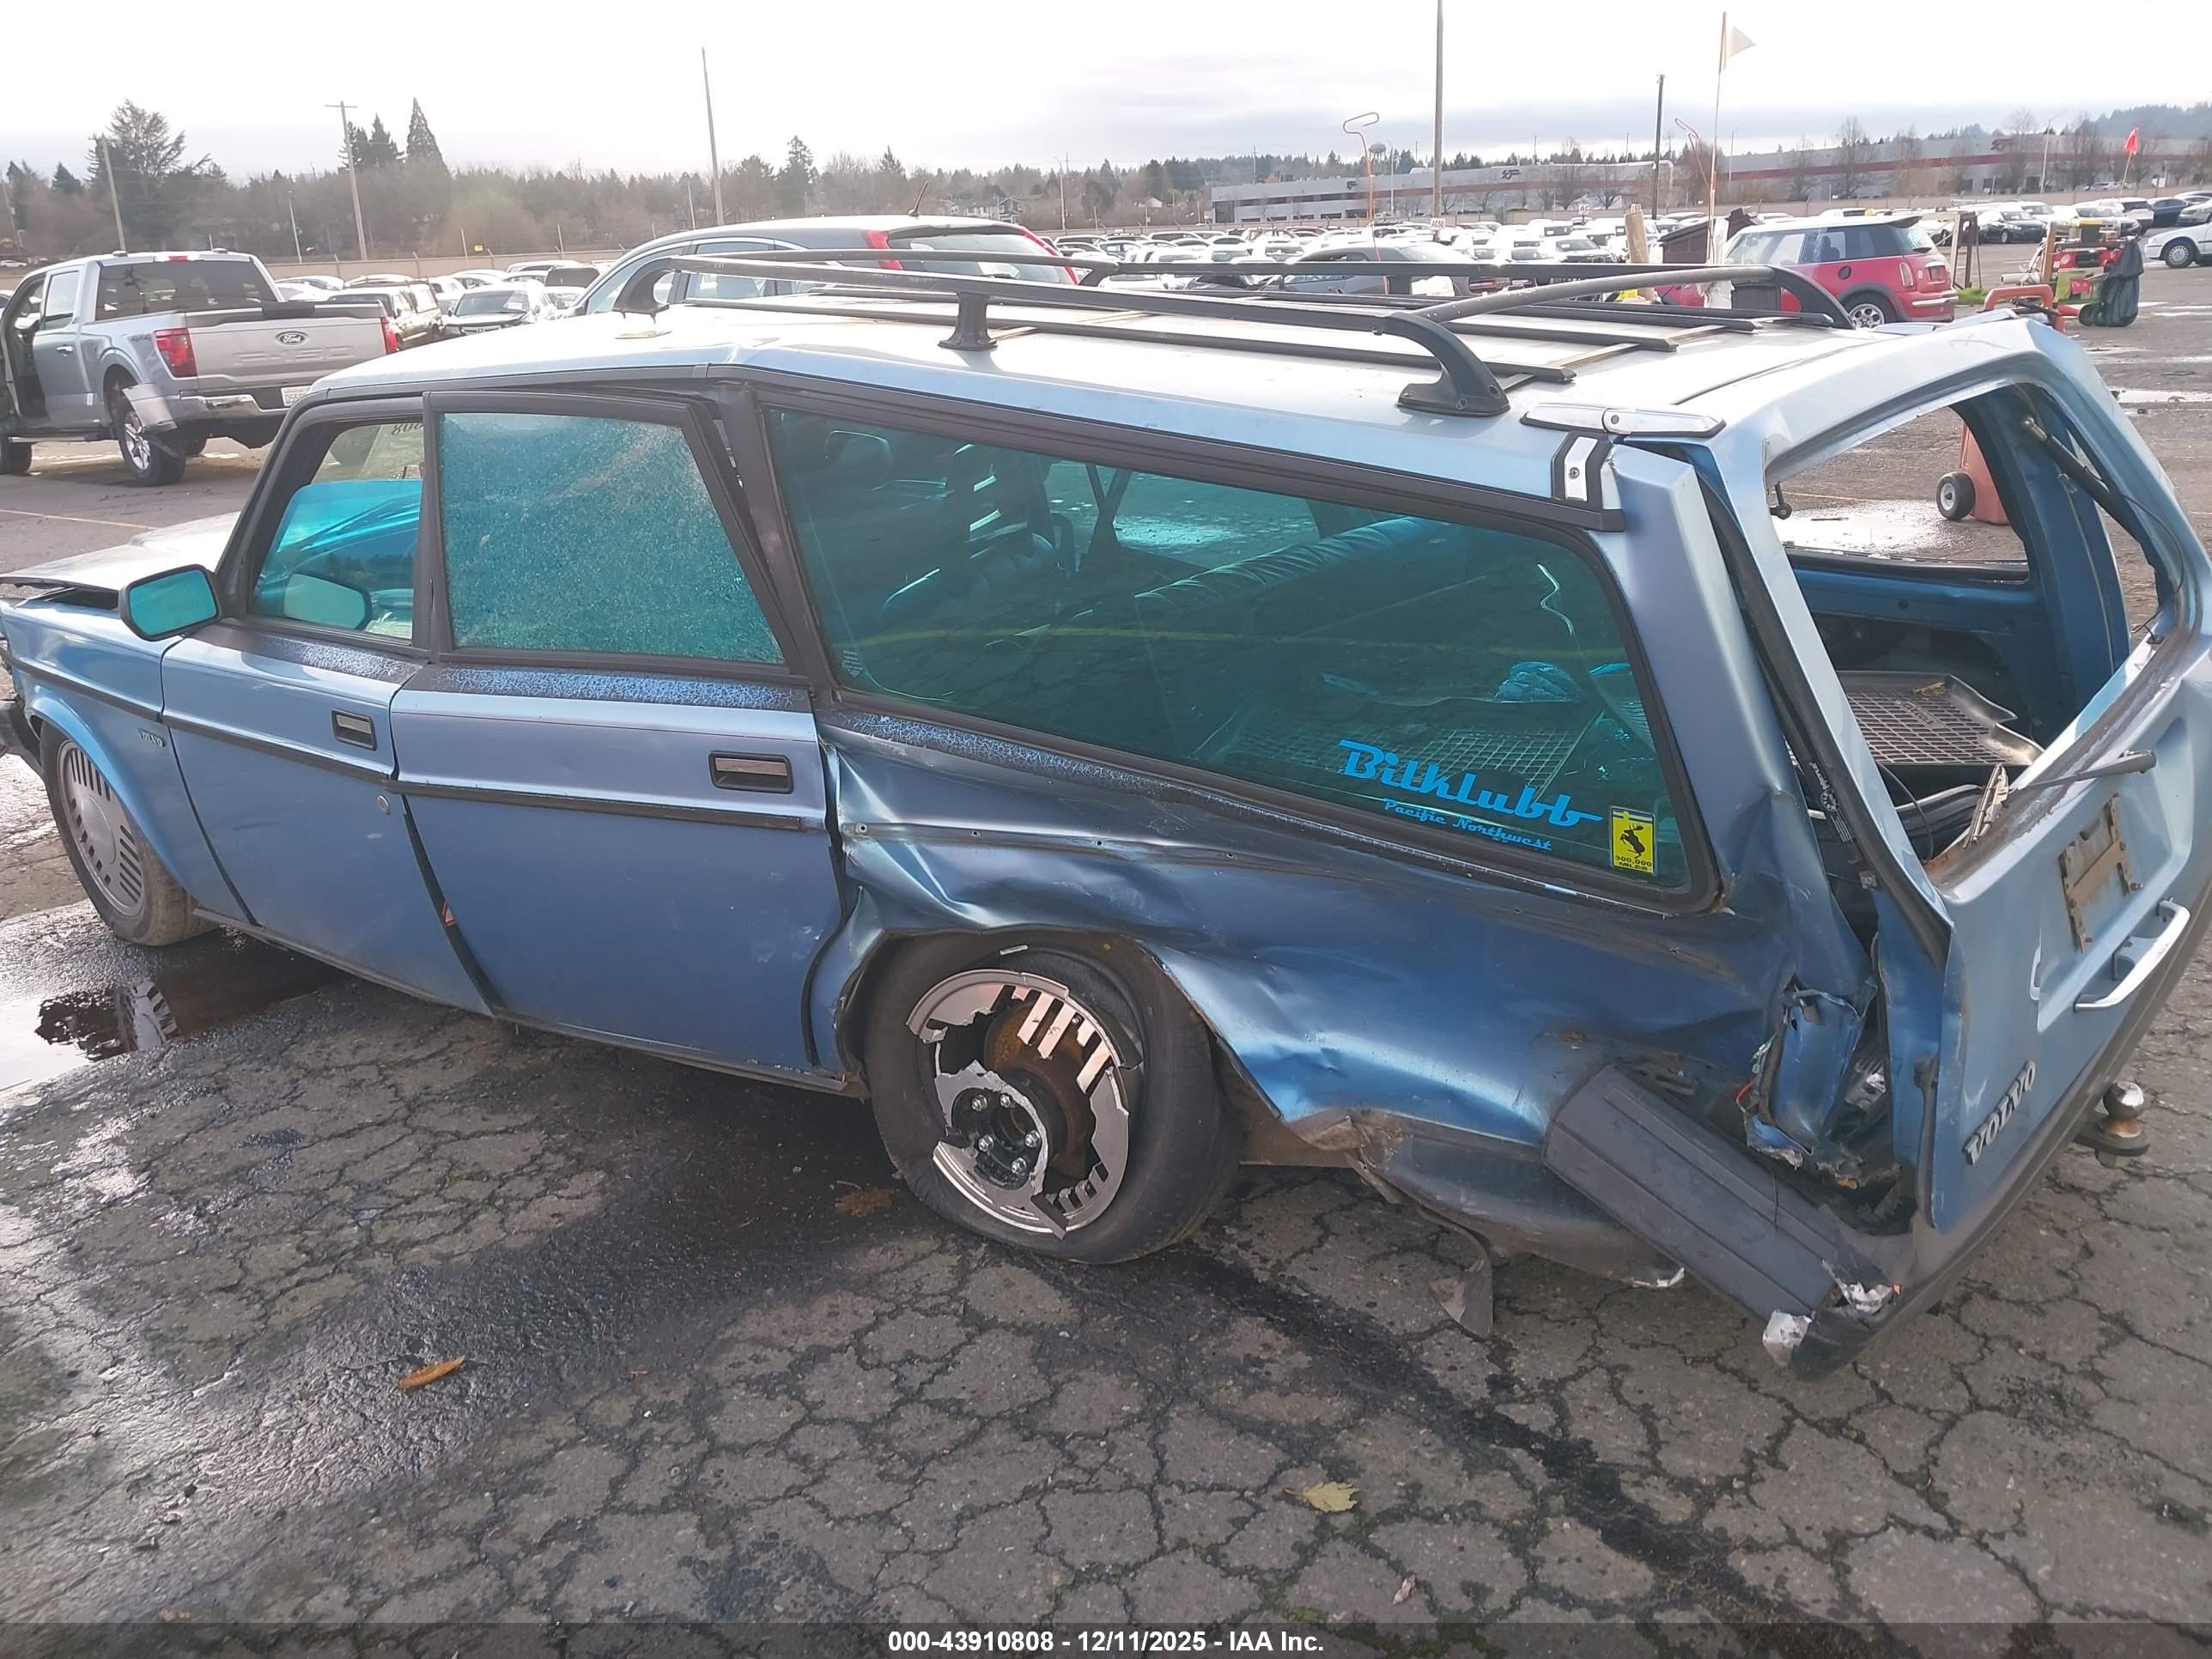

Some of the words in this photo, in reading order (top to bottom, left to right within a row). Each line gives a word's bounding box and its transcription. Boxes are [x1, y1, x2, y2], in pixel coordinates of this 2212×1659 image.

[283, 333, 301, 343] Ford
[138, 728, 165, 747] VOLVO
[1338, 739, 1603, 827] Bilklubb
[1383, 799, 1447, 823] Pacific
[1452, 817, 1552, 851] Northwest
[1620, 861, 1648, 871] MILES
[1963, 1060, 2036, 1166] VOLVO
